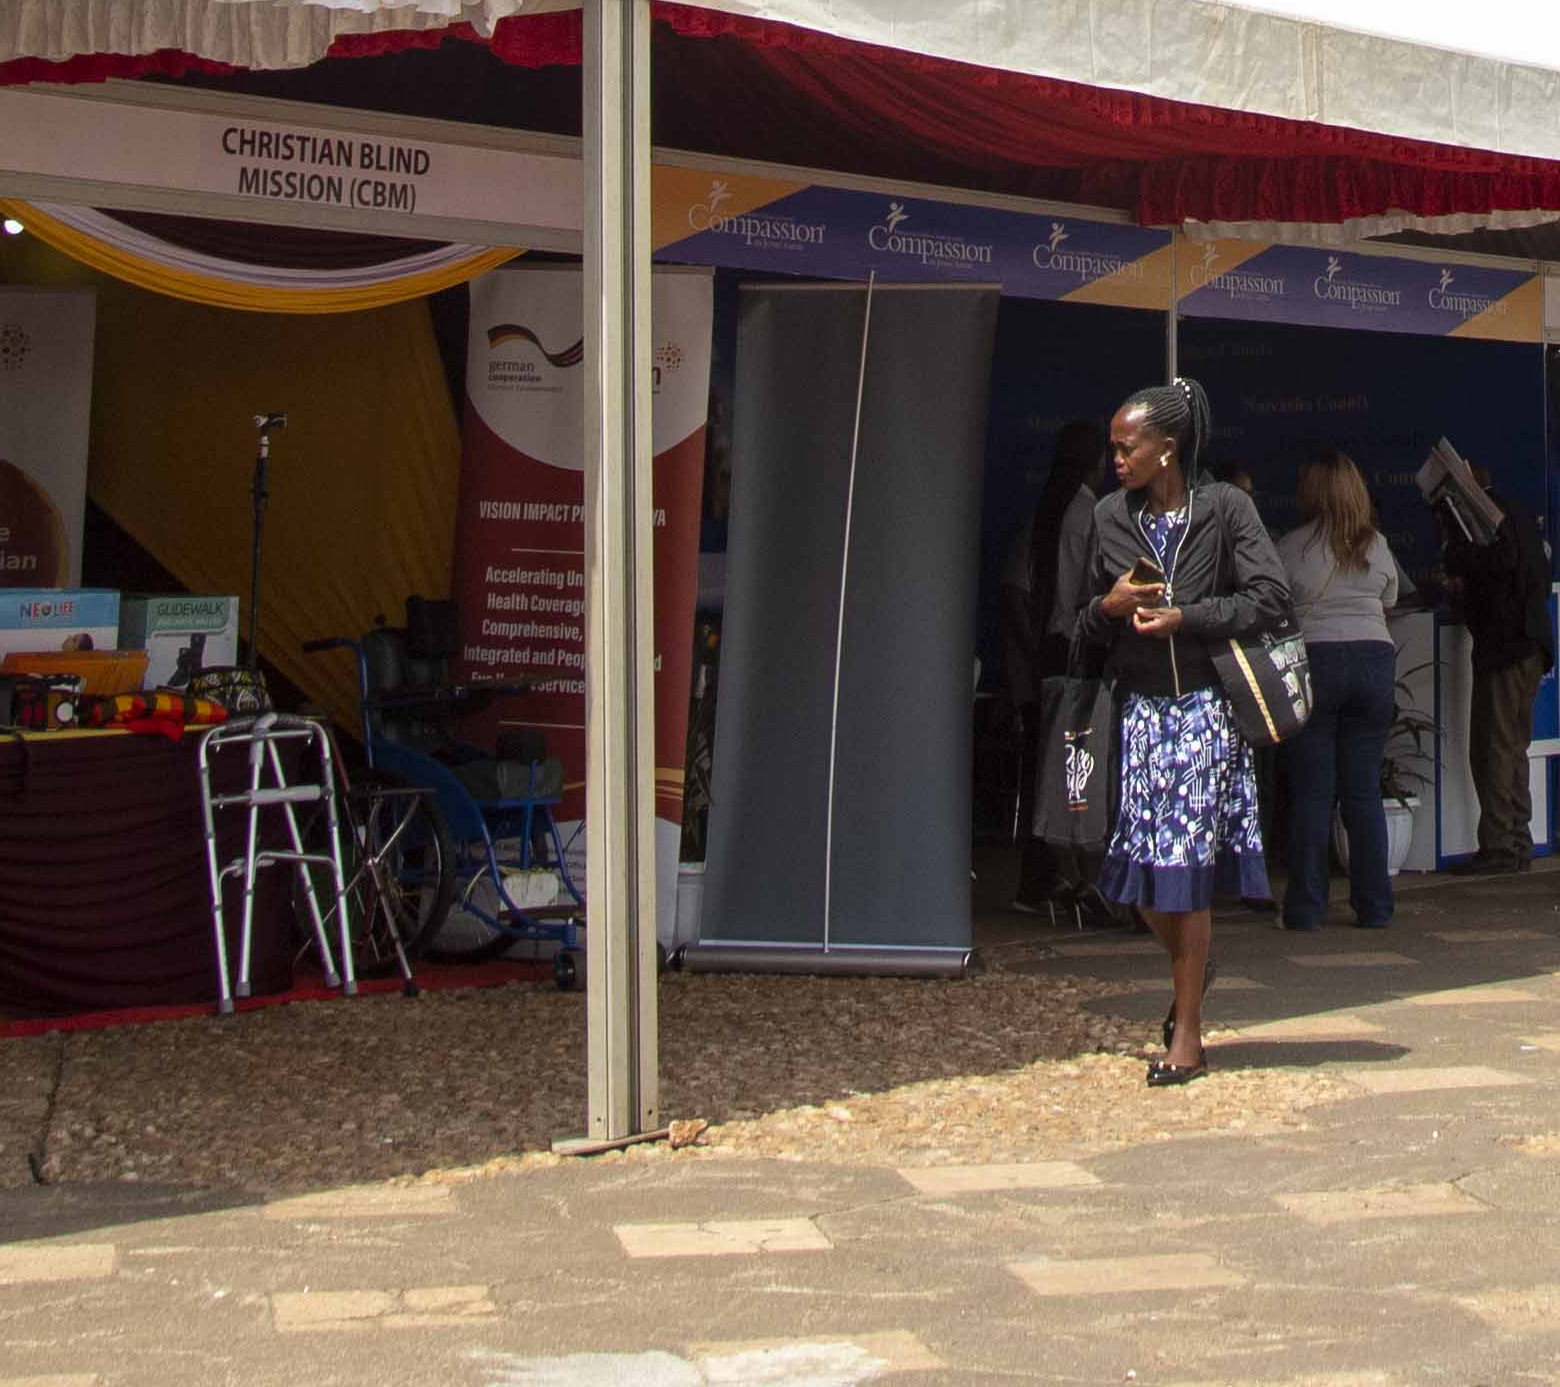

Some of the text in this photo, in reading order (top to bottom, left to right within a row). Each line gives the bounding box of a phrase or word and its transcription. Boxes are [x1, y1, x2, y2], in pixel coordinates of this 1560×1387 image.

[222, 127, 430, 175] CHRISTIAN BLIND
[239, 166, 416, 215] MISSION (CBM)
[689, 204, 826, 245] Compassion
[868, 225, 993, 264] Compassion
[1033, 244, 1144, 280] Compassion
[1190, 266, 1285, 299] Compassion
[1314, 277, 1400, 309] Compassion
[1428, 287, 1507, 318] Compassion
[488, 361, 534, 374] german
[479, 499, 521, 521] VISION
[523, 502, 569, 523] IMPACT
[485, 566, 565, 590] Accelerating
[157, 602, 225, 617] GLIDEWALK
[487, 592, 529, 613] Health
[481, 618, 584, 644] Comprehensive,
[464, 644, 530, 667] Integrated
[532, 648, 555, 667] and
